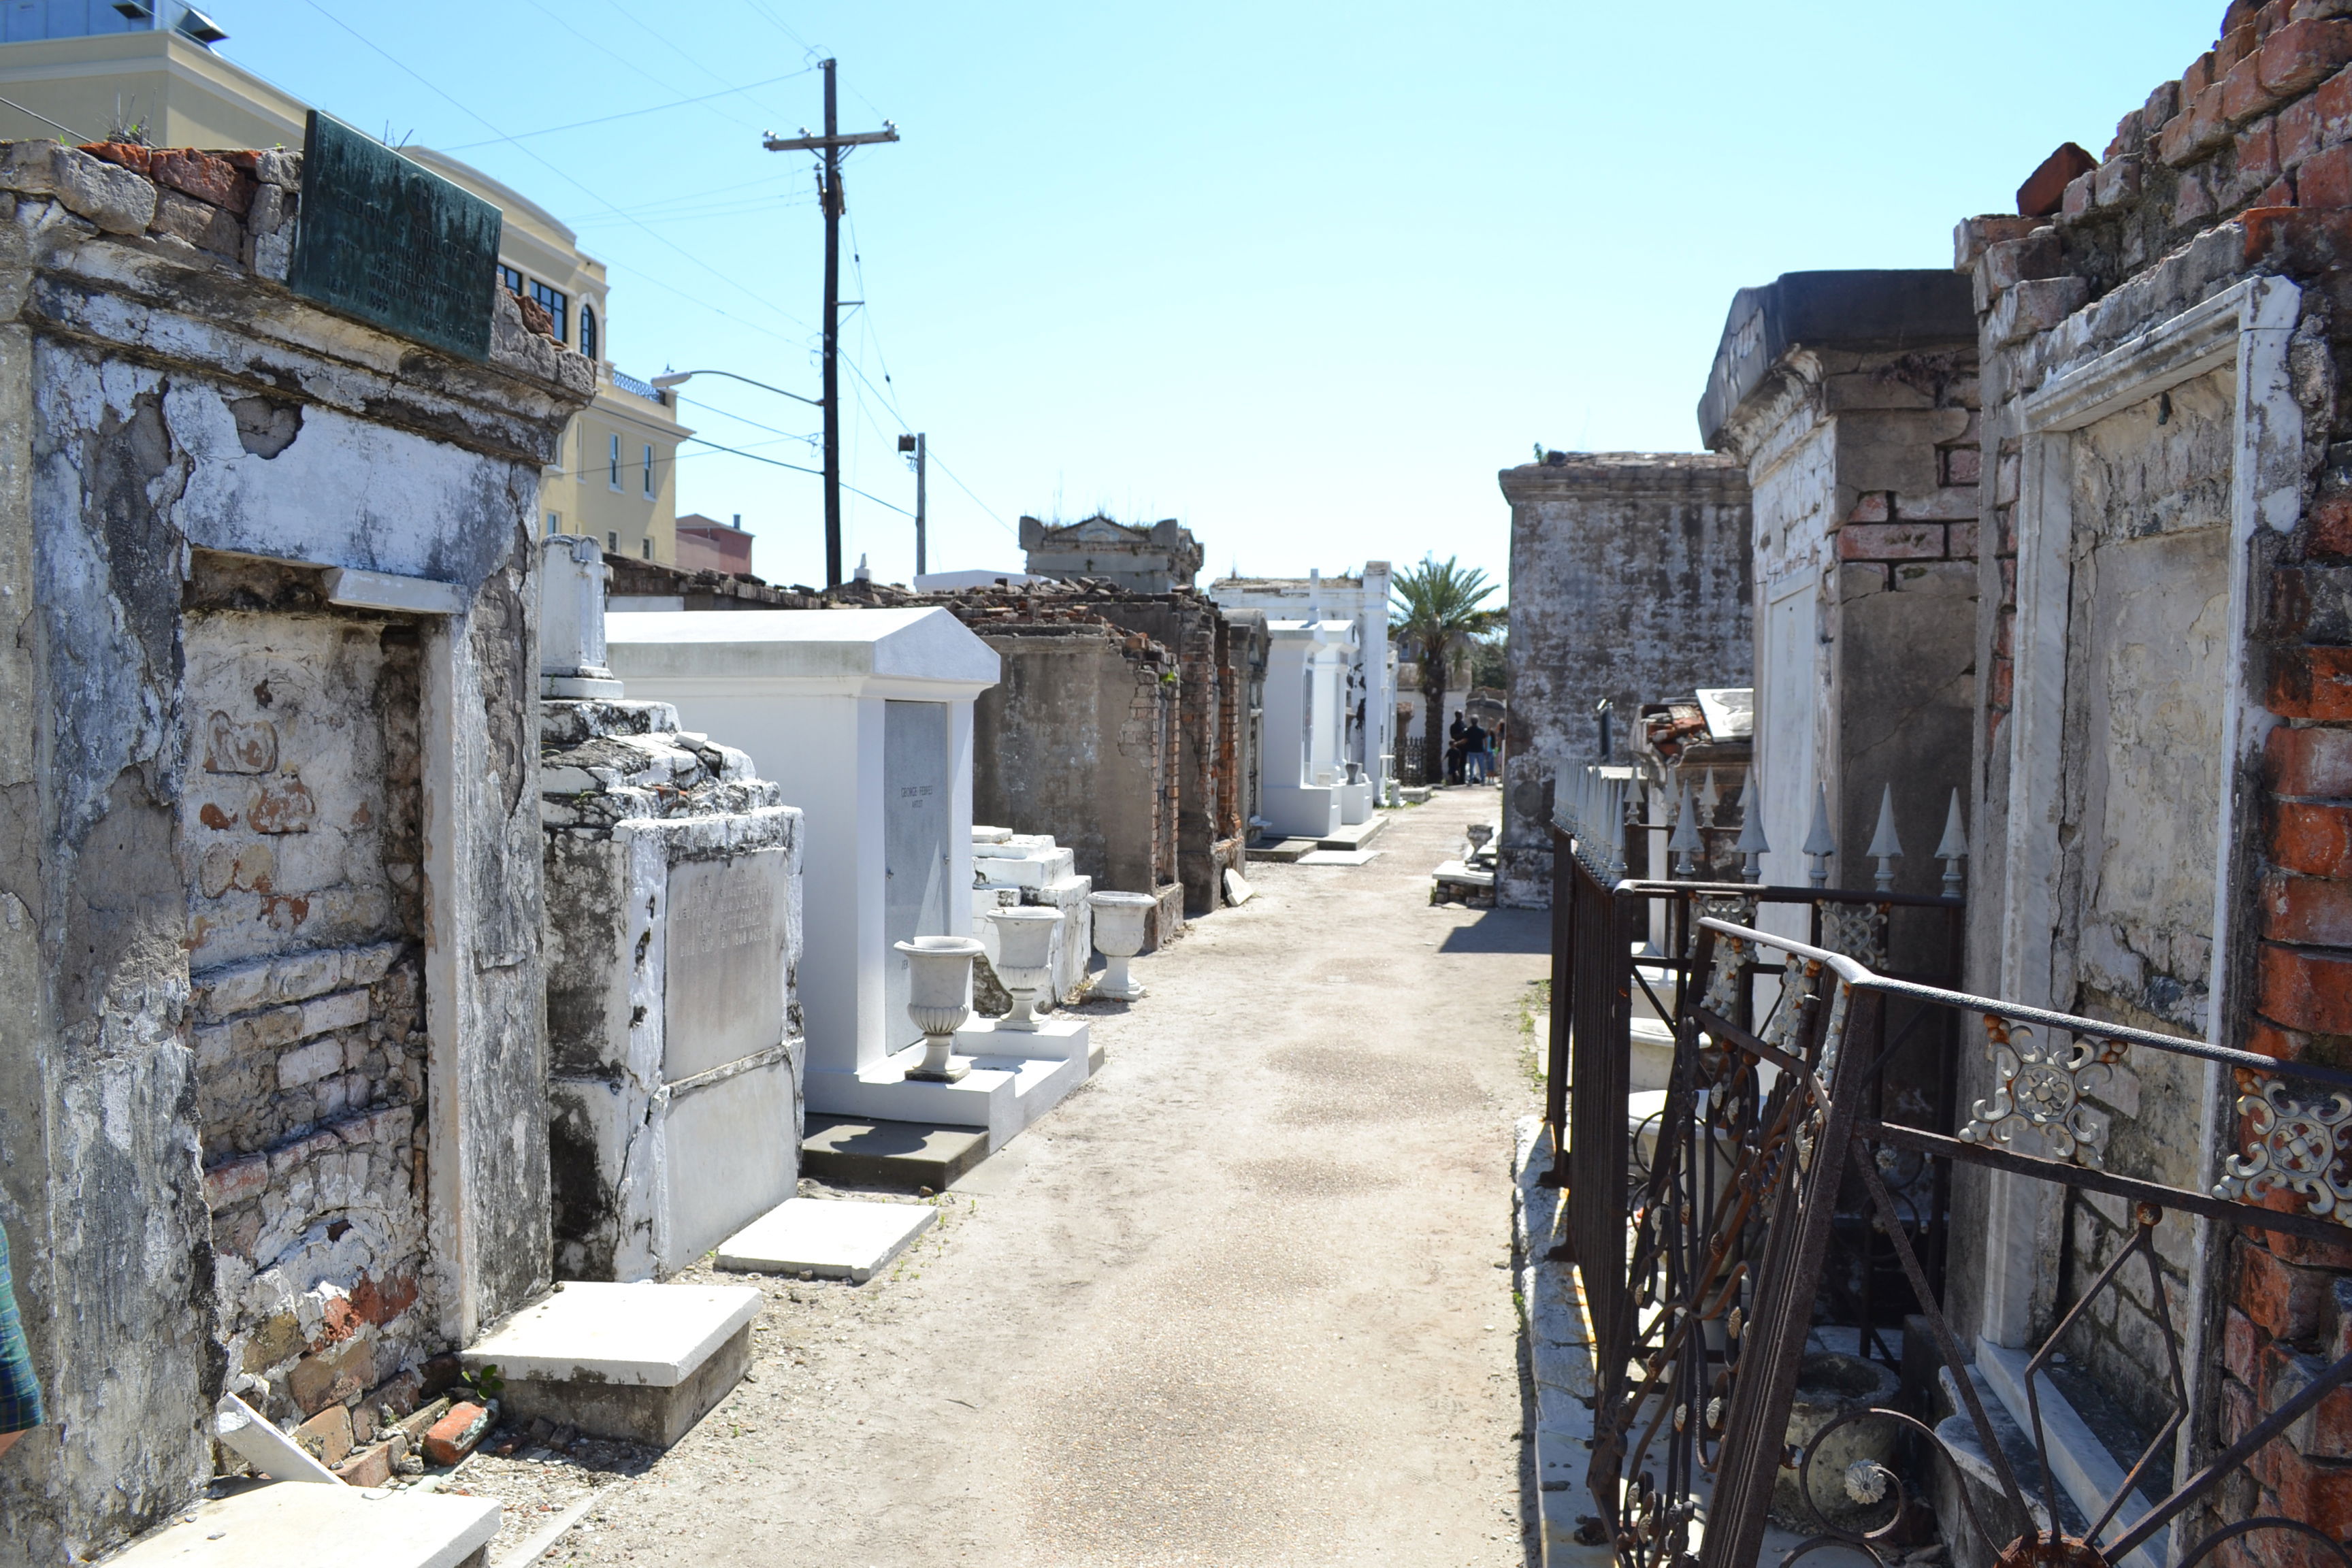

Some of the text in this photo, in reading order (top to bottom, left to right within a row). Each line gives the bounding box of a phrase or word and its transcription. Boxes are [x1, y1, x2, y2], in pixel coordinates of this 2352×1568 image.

[337, 189, 387, 228] ELDON
[412, 224, 459, 263] WILLOZ
[466, 250, 480, 272] SR
[335, 237, 359, 257] PVT
[395, 261, 426, 287] FIELD
[428, 278, 473, 308] HOSPITAL
[380, 239, 440, 274] LOUISIANA
[366, 290, 389, 314] 1899
[368, 272, 408, 299] WORLD
[413, 290, 434, 310] WAR
[900, 786, 917, 798] GEORGE
